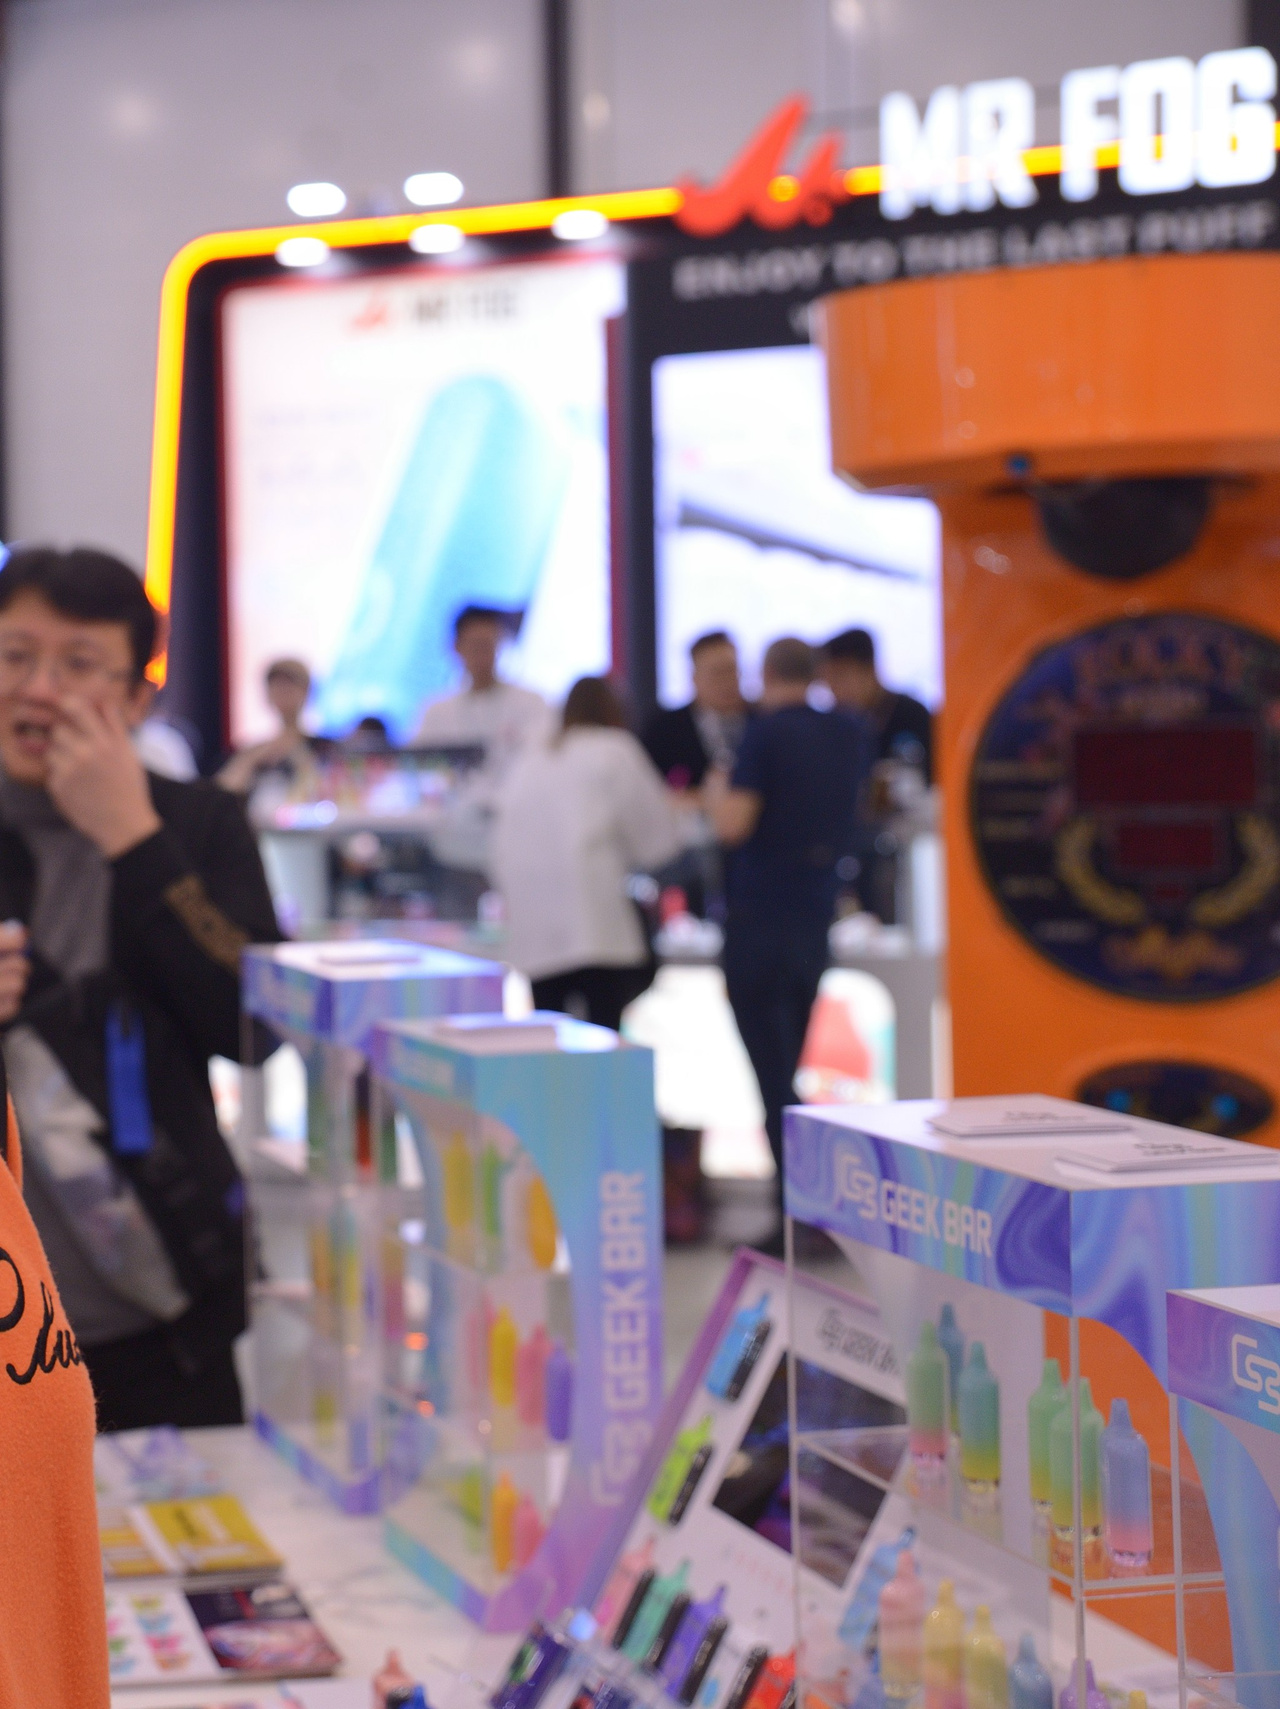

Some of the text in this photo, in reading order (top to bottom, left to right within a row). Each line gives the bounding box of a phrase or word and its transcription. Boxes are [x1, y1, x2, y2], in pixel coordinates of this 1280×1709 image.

[878, 46, 1278, 221] MR FOG
[833, 238, 900, 284] TO
[904, 228, 999, 274] THE
[1004, 214, 1131, 267] LAST
[1137, 201, 1276, 254] PUFF
[600, 1172, 647, 1270] BAR
[881, 1179, 941, 1240] GEEK
[943, 1199, 993, 1258] BAR
[601, 1278, 649, 1410] GEEK
